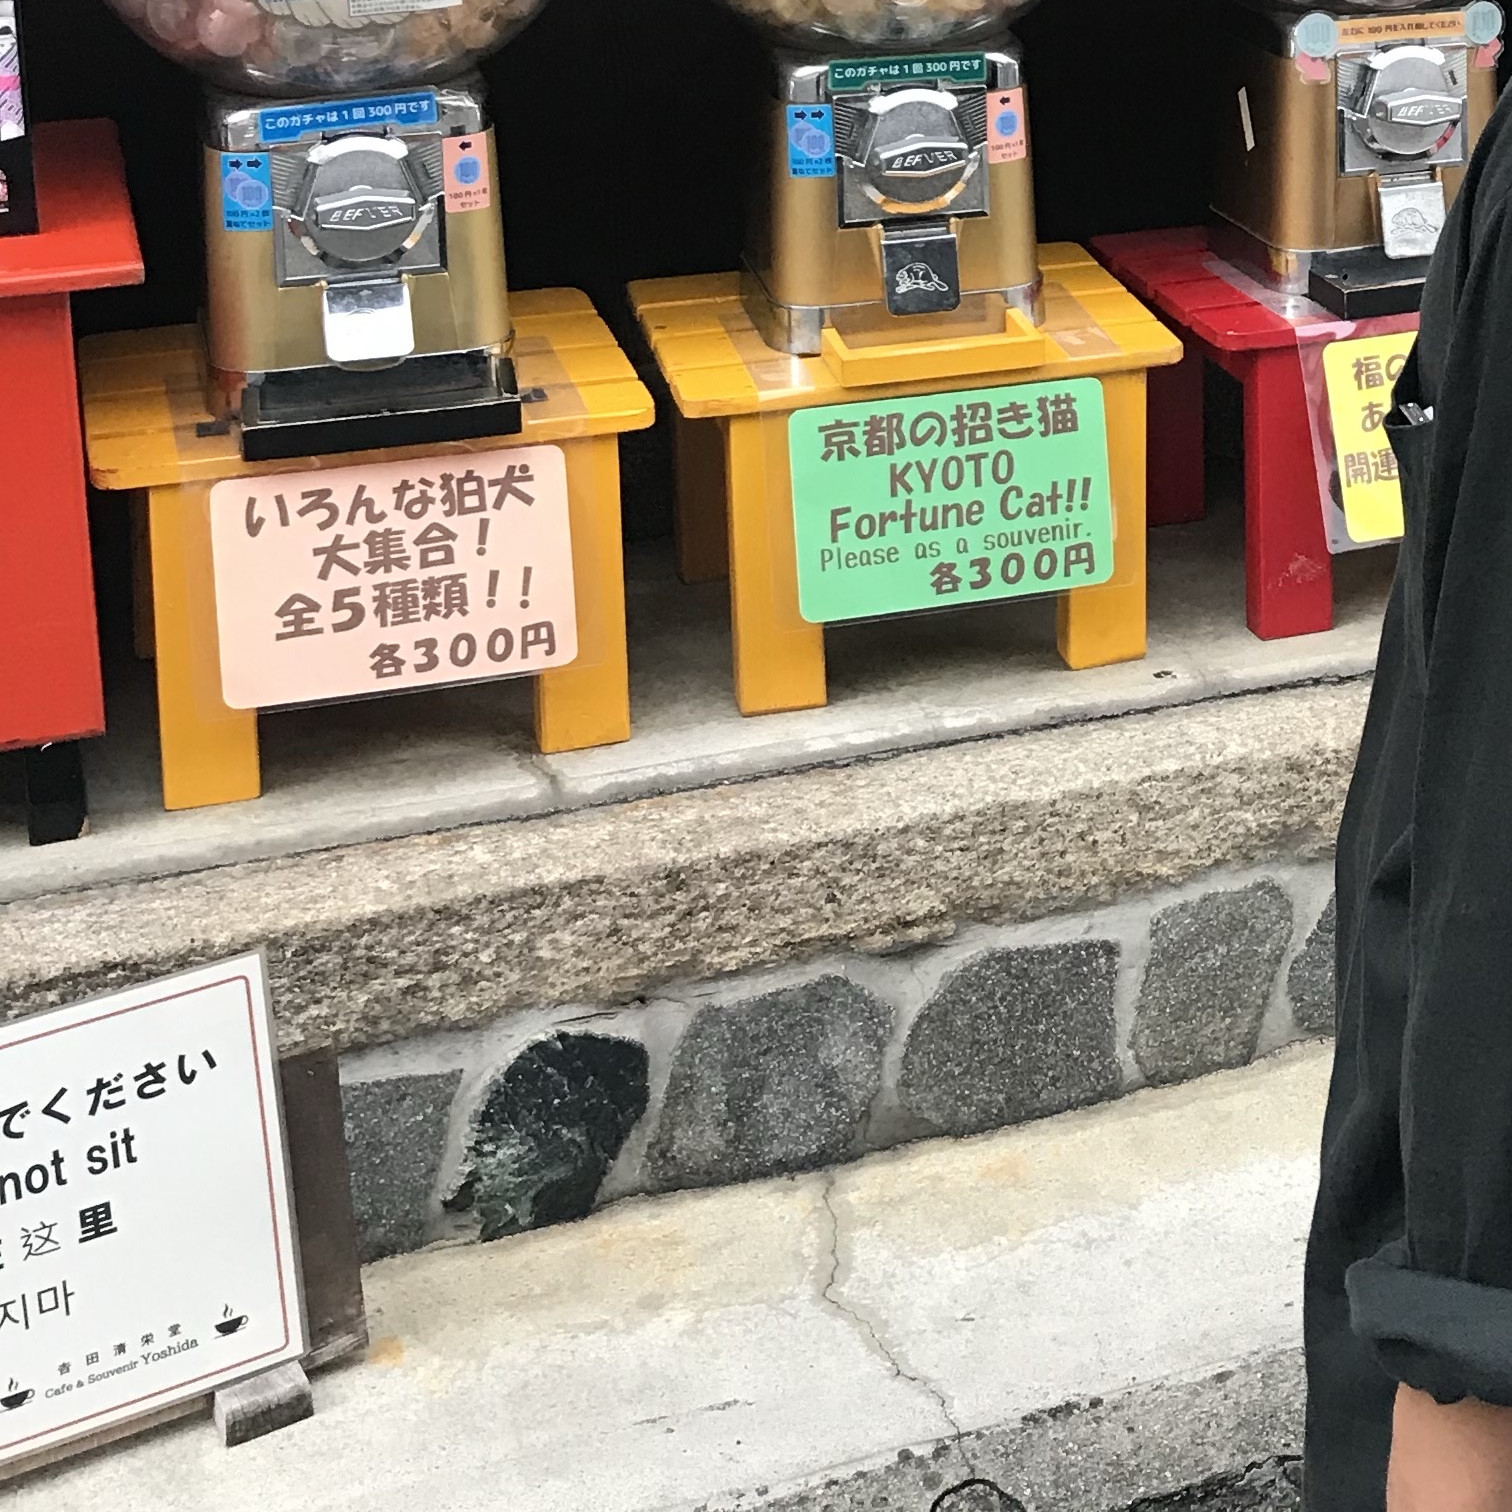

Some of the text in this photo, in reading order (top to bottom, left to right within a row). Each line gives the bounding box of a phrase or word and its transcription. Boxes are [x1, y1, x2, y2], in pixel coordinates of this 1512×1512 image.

[818, 392, 1080, 463] 京都の招き猫
[245, 462, 535, 538] いろんな狛犬
[889, 448, 1015, 498] KYOTO
[1343, 447, 1400, 488] 開運
[830, 477, 1092, 544] Fortune Cat!!
[312, 517, 491, 582] 大集合!
[820, 518, 1092, 572] Please as a souvenir.
[930, 541, 1096, 596] 各300円
[274, 565, 534, 642] 全5種類!!
[369, 620, 557, 680] 各300円
[0, 1049, 217, 1140] でください
[0, 1127, 137, 1205] not sit
[0, 1200, 118, 1271] 这里
[0, 1279, 75, 1330] 지마
[44, 1338, 199, 1399] Cafe & Souvenir Yoshida
